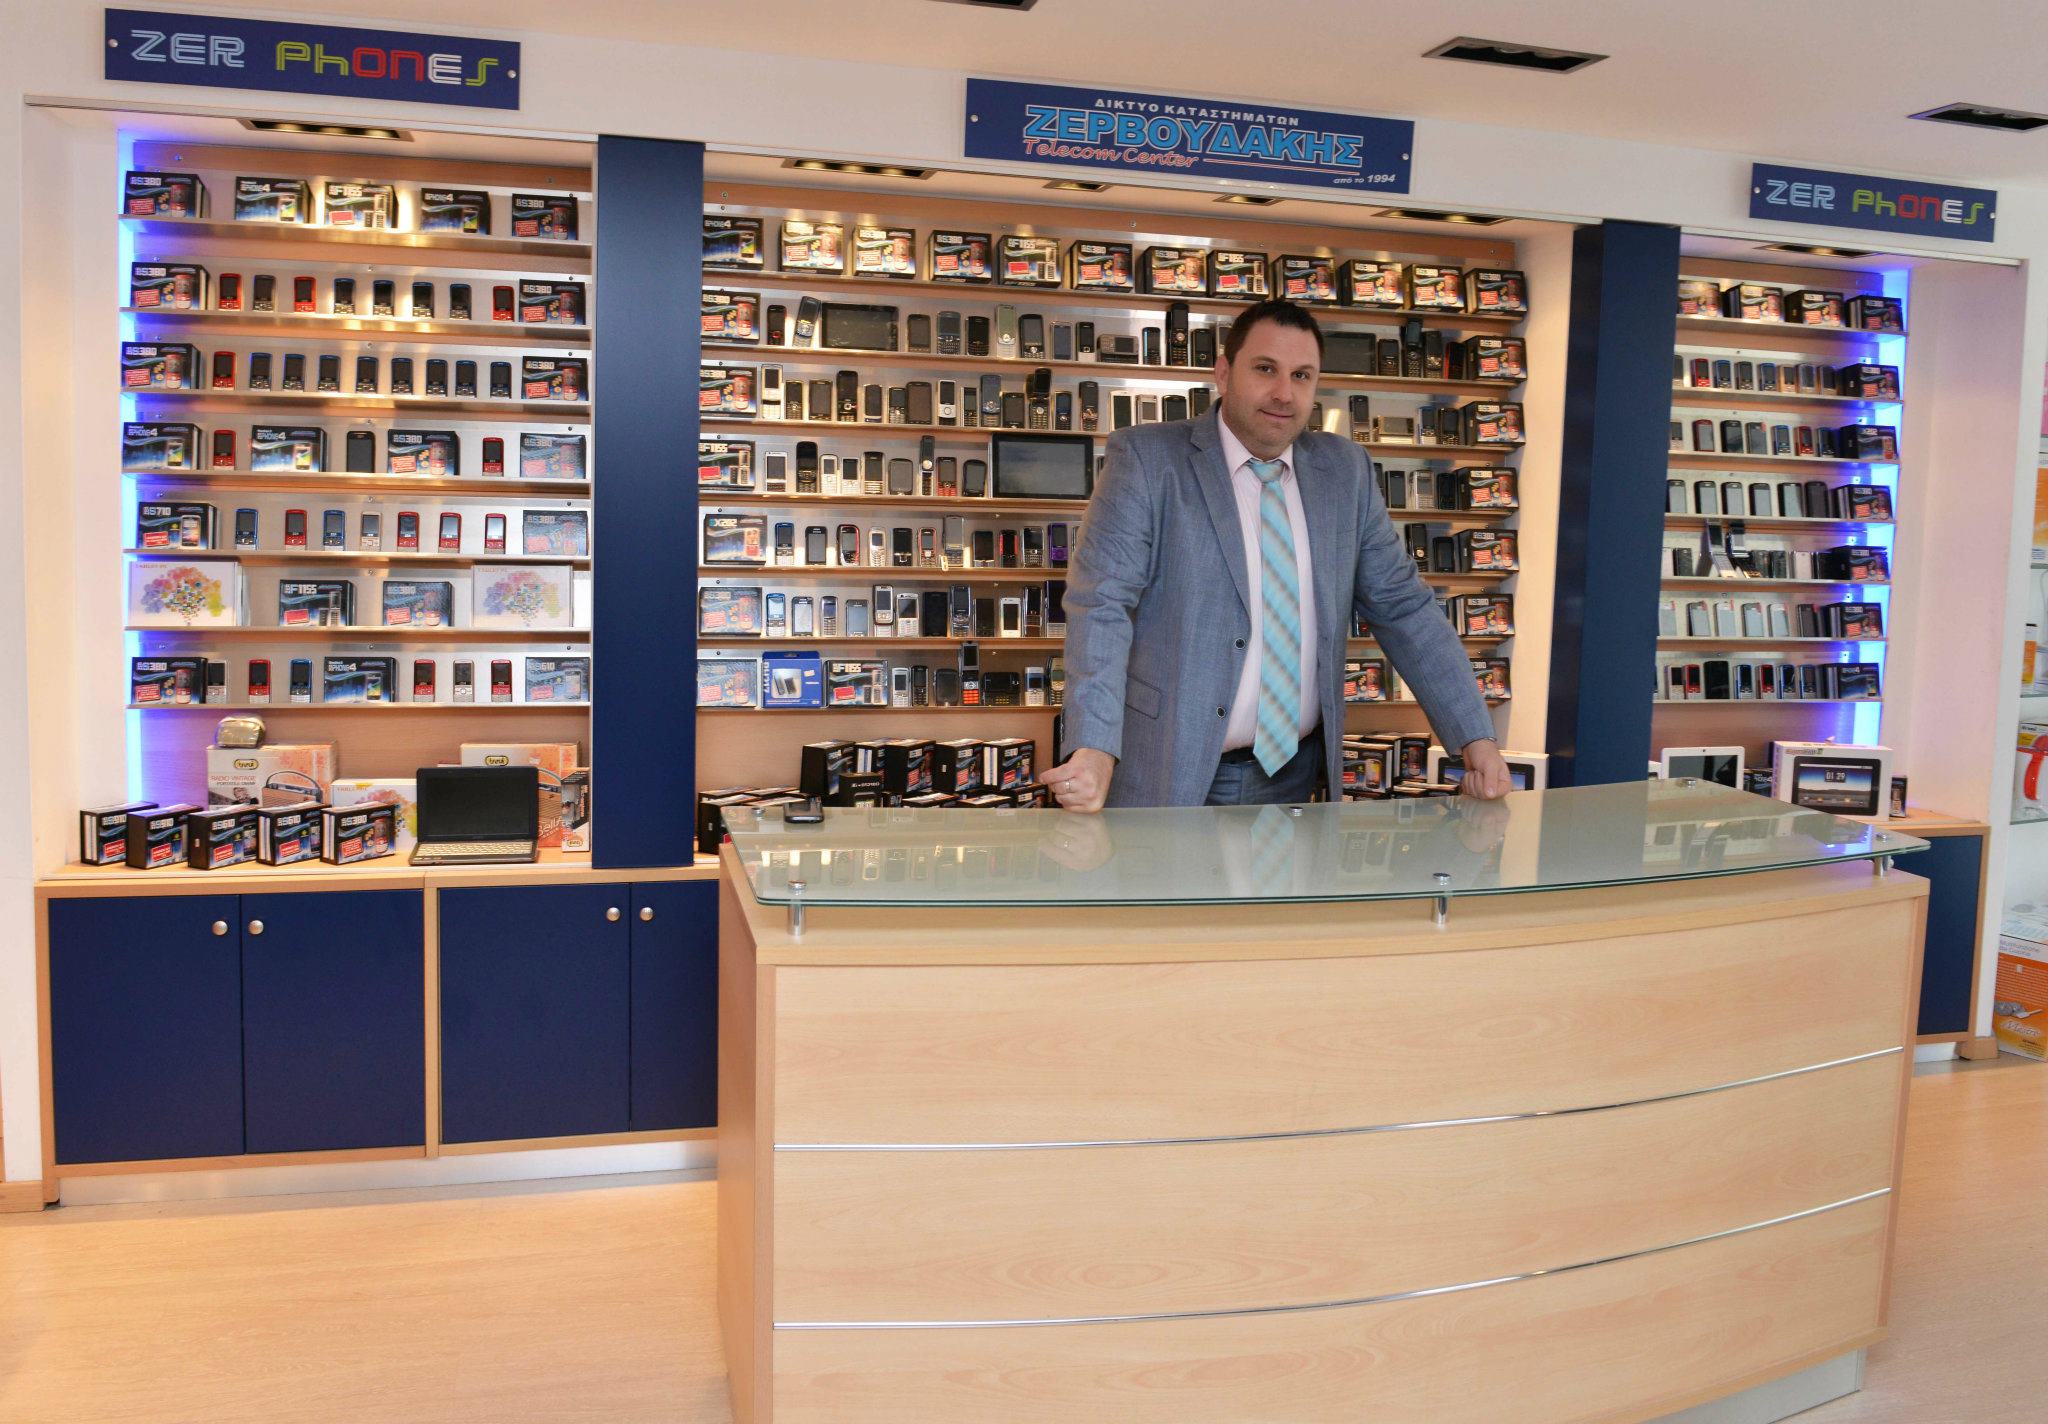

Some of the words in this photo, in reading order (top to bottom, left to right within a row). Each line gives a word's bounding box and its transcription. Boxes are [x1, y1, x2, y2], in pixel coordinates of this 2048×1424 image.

[130, 28, 246, 69] ZER
[1094, 98, 1160, 114] ΔΙΚΤΥΟ
[1163, 101, 1301, 127] ΚΑΤΑΣΤΗΜΑΤΩΝ
[1022, 103, 1364, 168] ΖΕΡΒΟΥΔΑΚΗΣ
[1022, 138, 1122, 162] Telecom
[1122, 147, 1200, 168] Center
[1366, 174, 1397, 185] 1994
[1764, 178, 1837, 211] ZER
